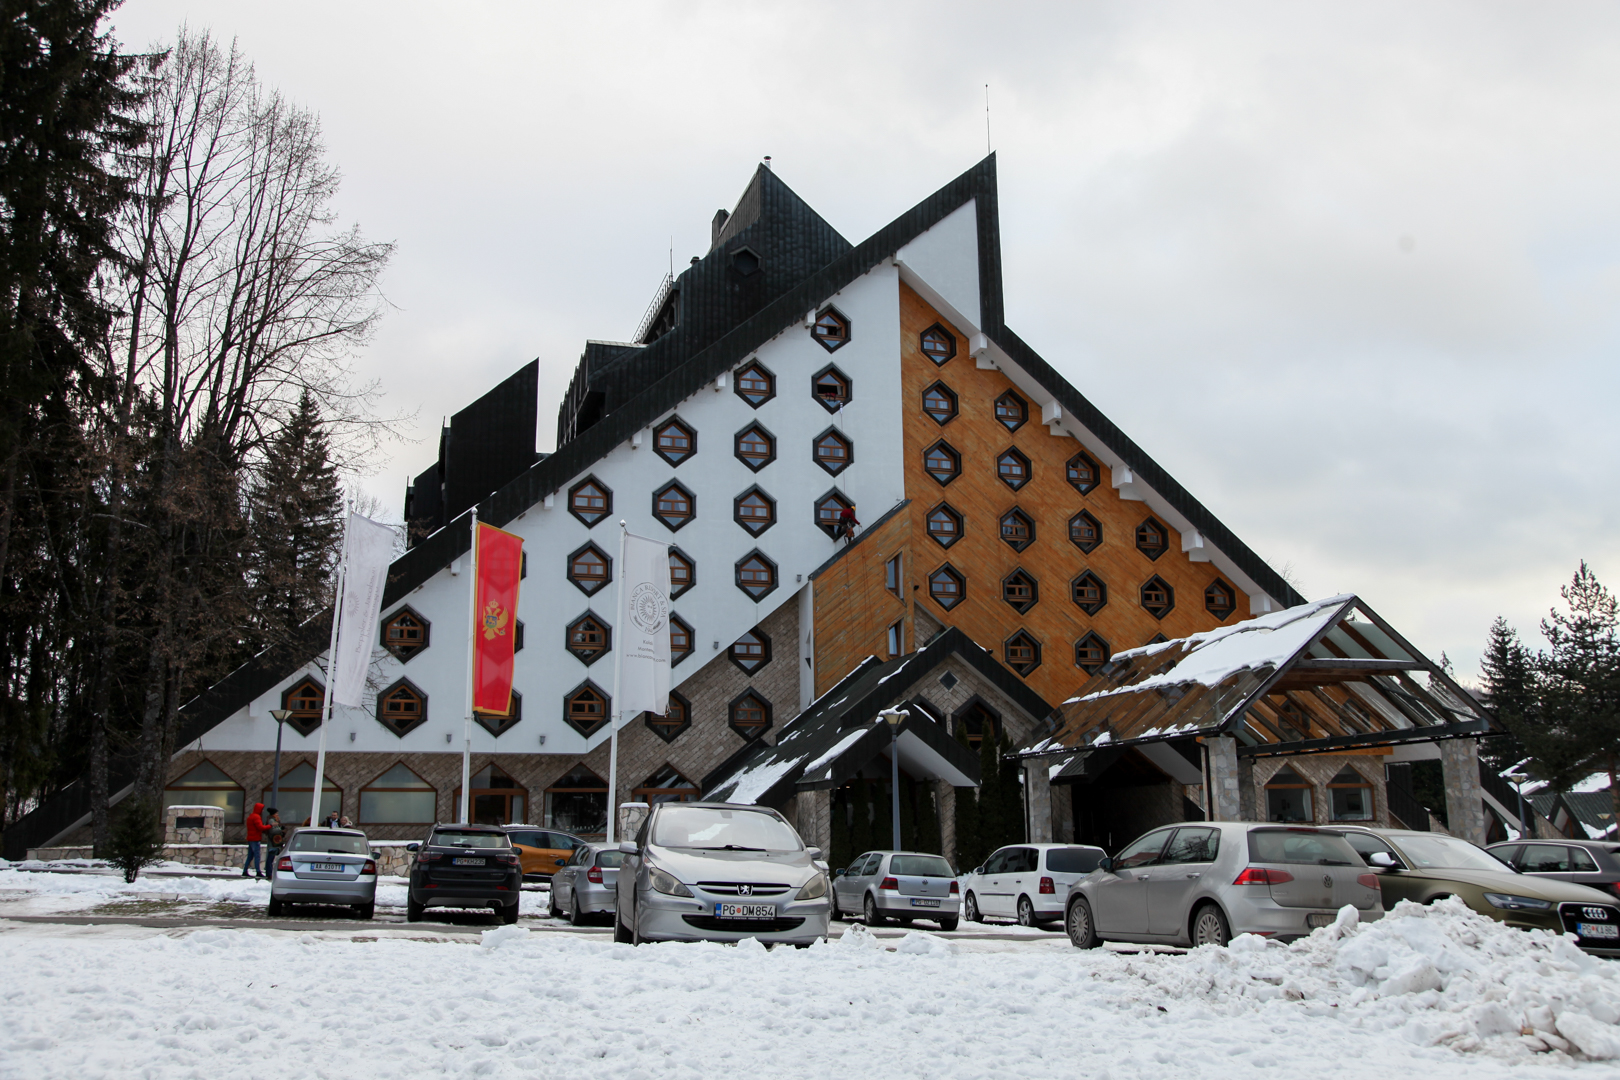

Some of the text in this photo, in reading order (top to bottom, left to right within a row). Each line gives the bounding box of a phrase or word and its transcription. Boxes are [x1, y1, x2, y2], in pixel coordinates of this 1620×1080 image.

[630, 587, 644, 611] BIANCA
[722, 904, 774, 917] PG DM854
